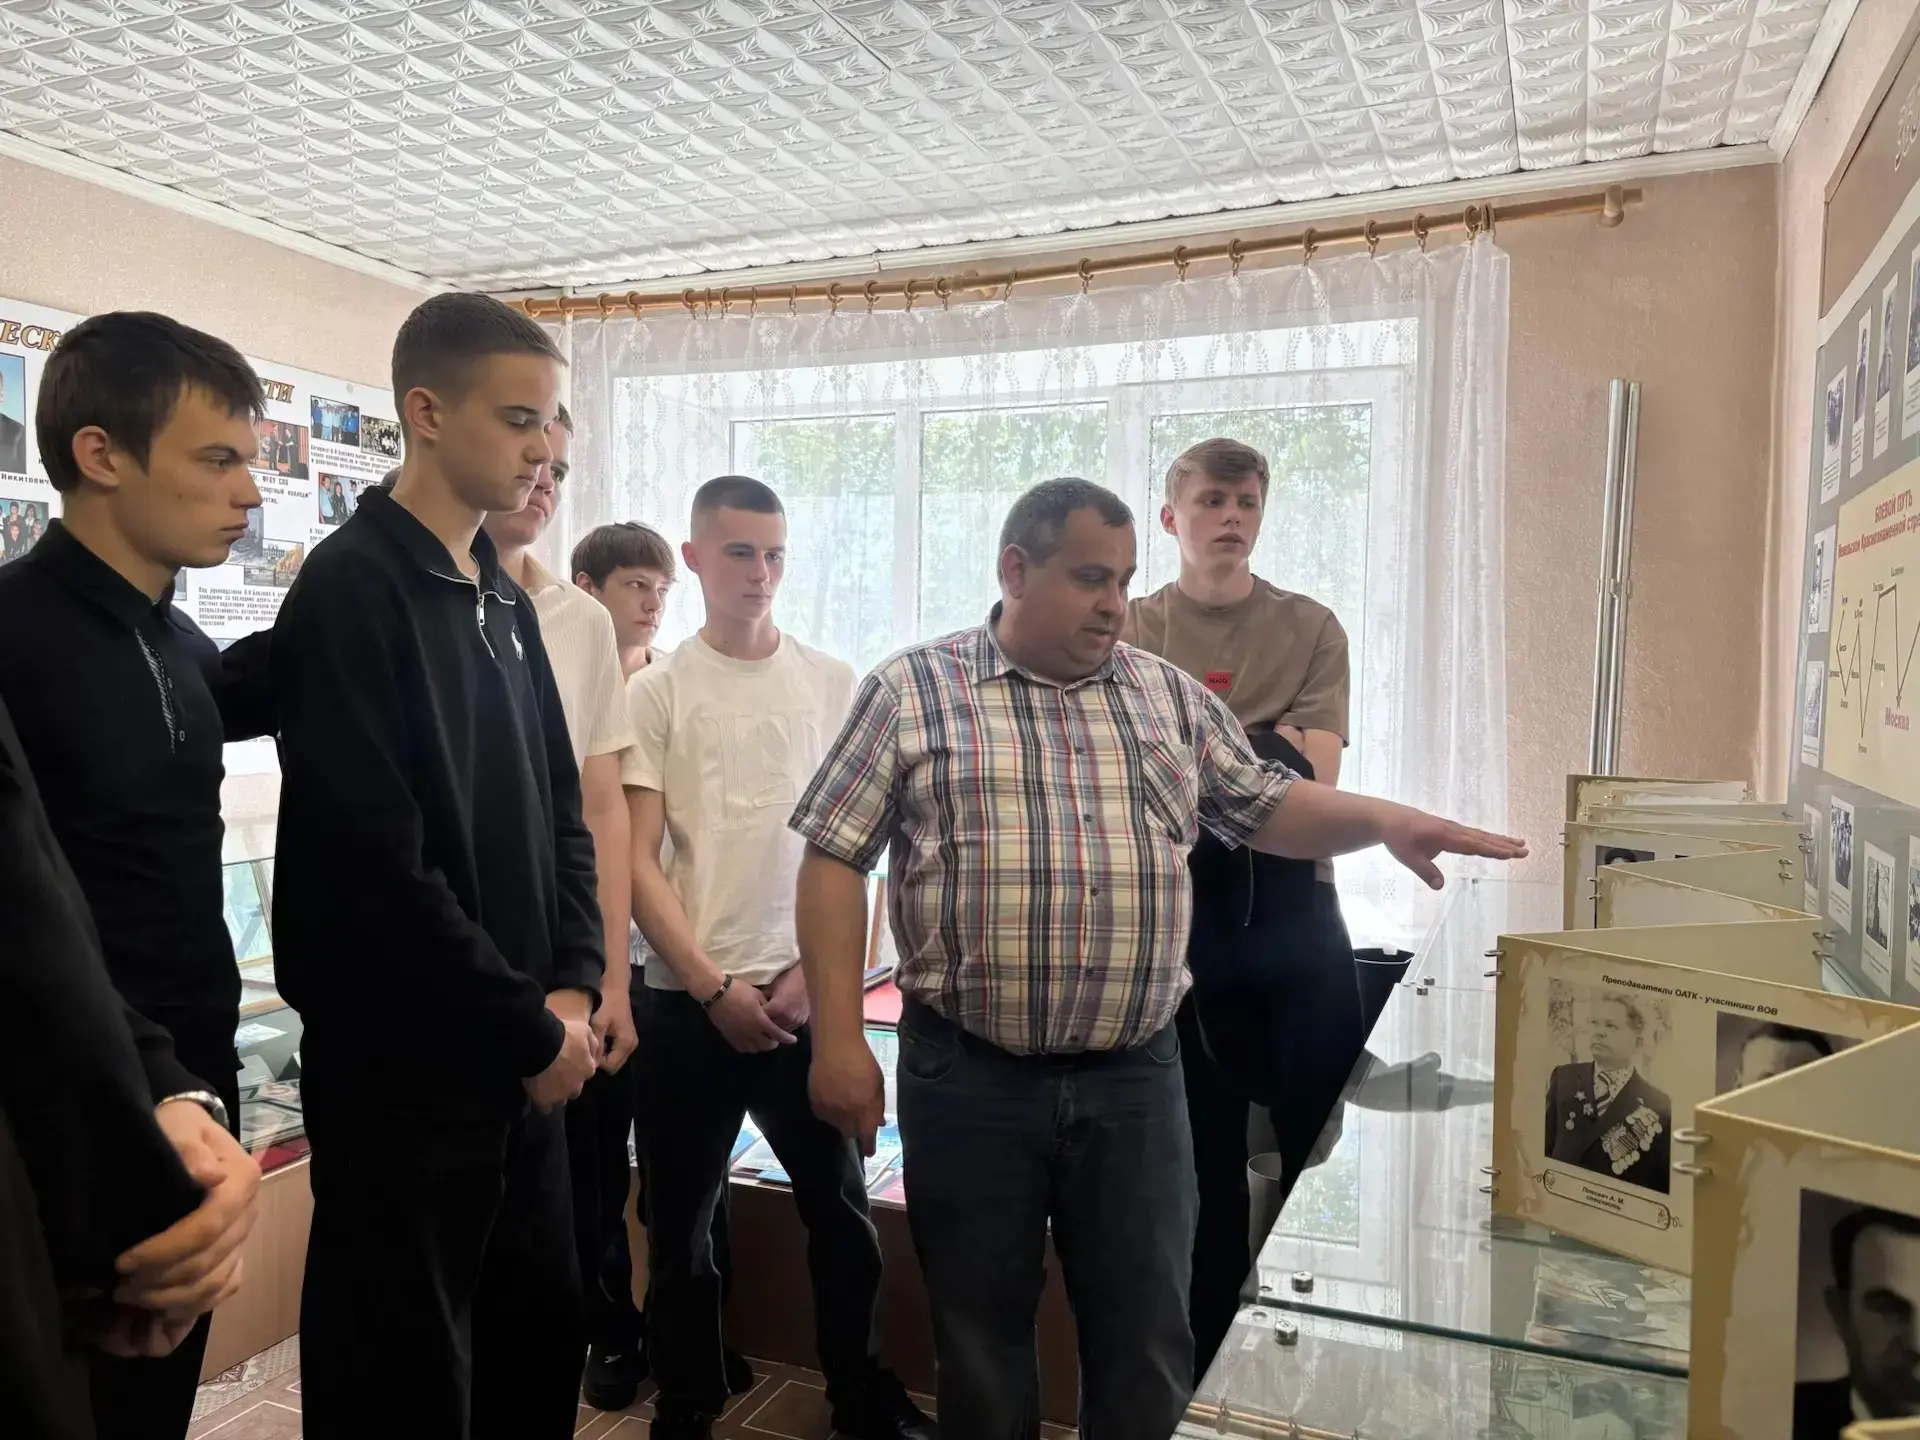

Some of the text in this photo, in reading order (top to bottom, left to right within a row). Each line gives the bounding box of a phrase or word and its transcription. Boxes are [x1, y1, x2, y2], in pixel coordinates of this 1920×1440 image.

[1875, 489, 1912, 523] БОЕВОЙ ПУТЬ
[1885, 707, 1909, 731] Москва
[1675, 989, 1698, 1000] ОАТК
[1705, 995, 1755, 1011] участники
[1757, 1005, 1778, 1016] ВОВ
